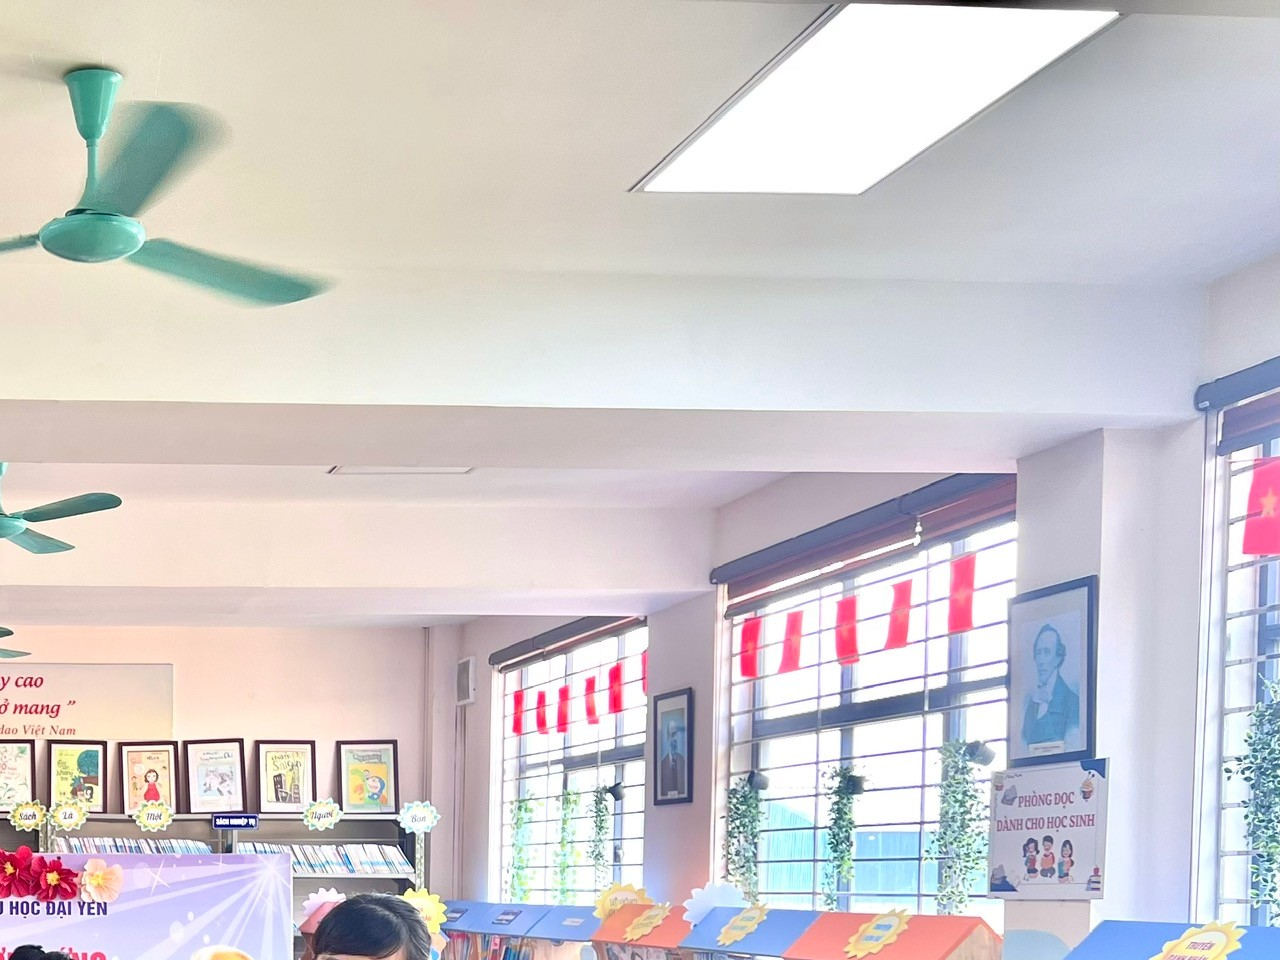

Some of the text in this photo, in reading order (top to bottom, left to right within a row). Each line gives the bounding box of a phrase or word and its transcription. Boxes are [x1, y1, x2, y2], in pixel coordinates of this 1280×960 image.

[15, 676, 44, 689] cao
[13, 704, 61, 719] mang
[23, 725, 46, 737] Việt
[49, 726, 76, 736] Nam
[1018, 791, 1075, 809] PHÒNG ĐỌC
[997, 814, 1095, 832] DÀNH CHO HỌC SINH
[10, 900, 41, 919] HỌC
[46, 900, 72, 919] ĐẠI
